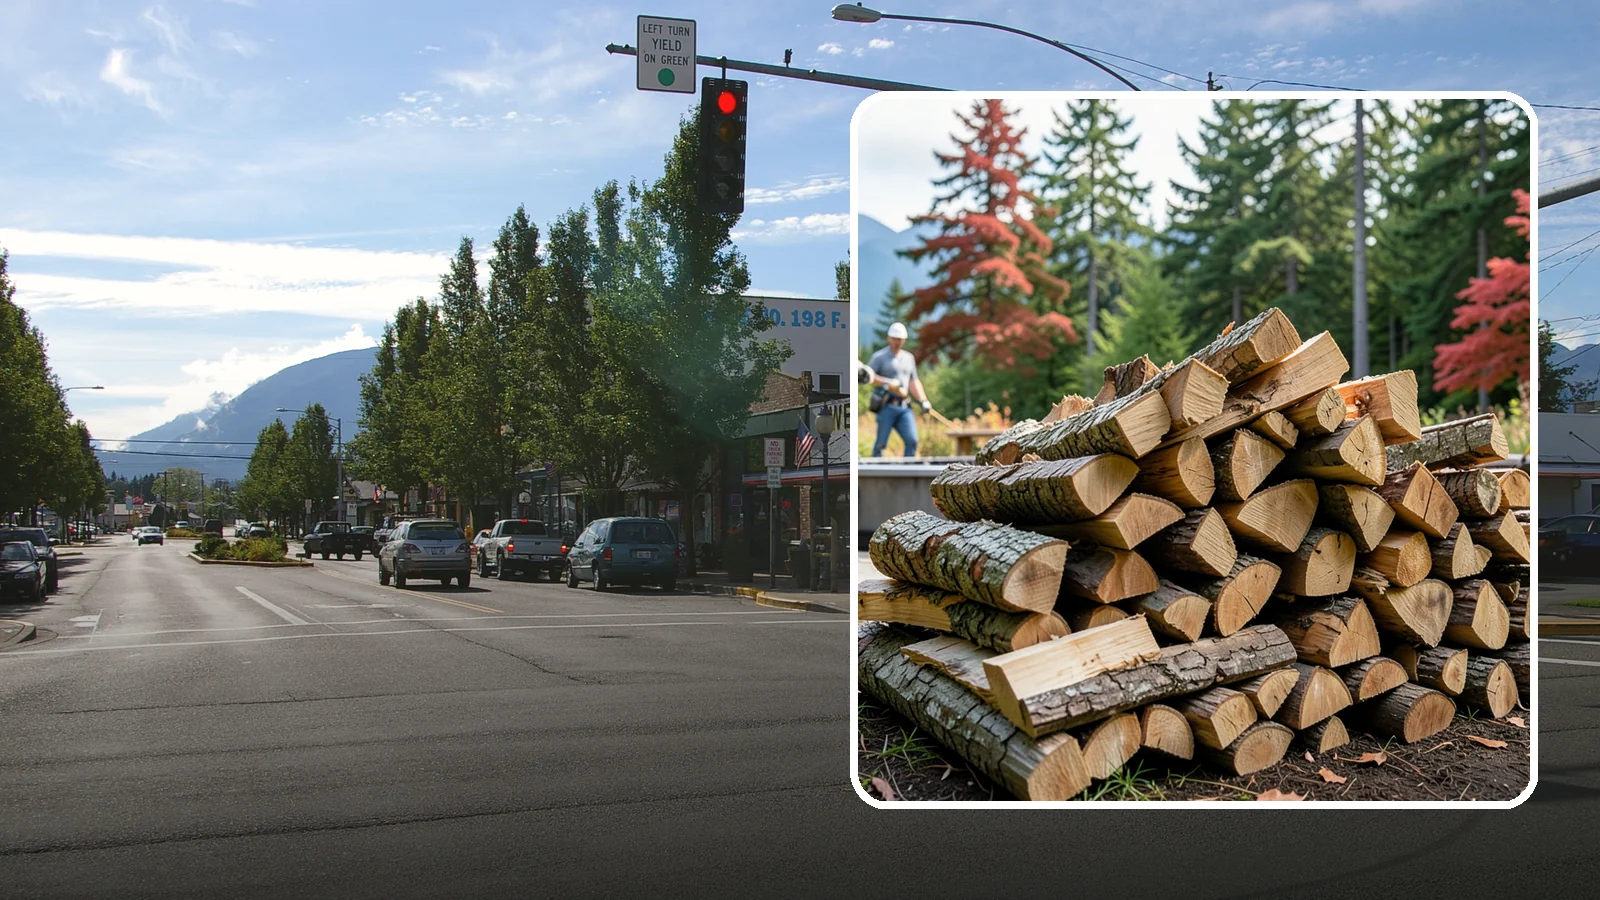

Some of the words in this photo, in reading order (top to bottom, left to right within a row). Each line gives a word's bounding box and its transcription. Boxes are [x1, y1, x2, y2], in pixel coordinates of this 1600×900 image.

[642, 23, 663, 34] LEFT
[668, 25, 690, 36] TURN
[652, 37, 682, 52] YIELD
[643, 53, 656, 64] ON
[661, 54, 689, 66] GREEN
[791, 309, 826, 328] 198
[831, 311, 847, 329] F.
